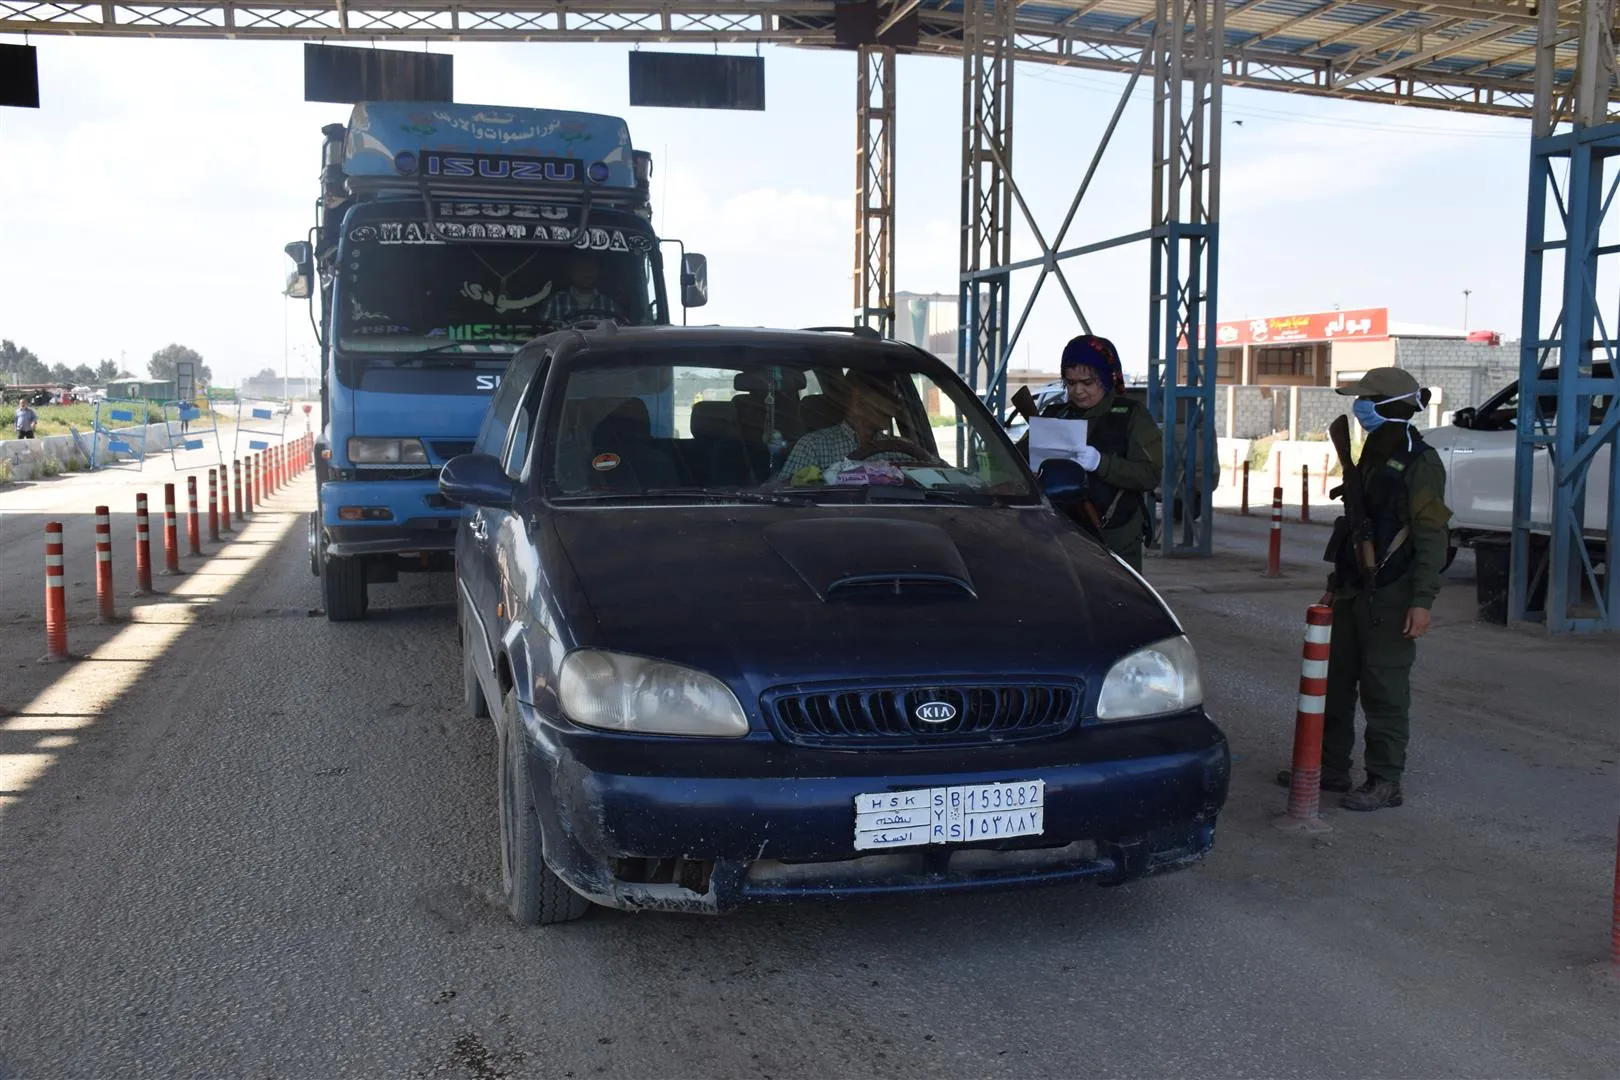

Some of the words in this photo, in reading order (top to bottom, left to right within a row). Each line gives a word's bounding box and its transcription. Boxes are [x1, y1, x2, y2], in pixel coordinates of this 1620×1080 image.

[428, 156, 576, 181] ISUZU
[439, 203, 569, 219] ISUZU
[476, 375, 501, 390] S
[922, 706, 951, 718] KIA
[967, 785, 1038, 811] 153882
[968, 811, 1038, 838] ١٥٣٨٨٢
[872, 831, 913, 843] الحسكة
